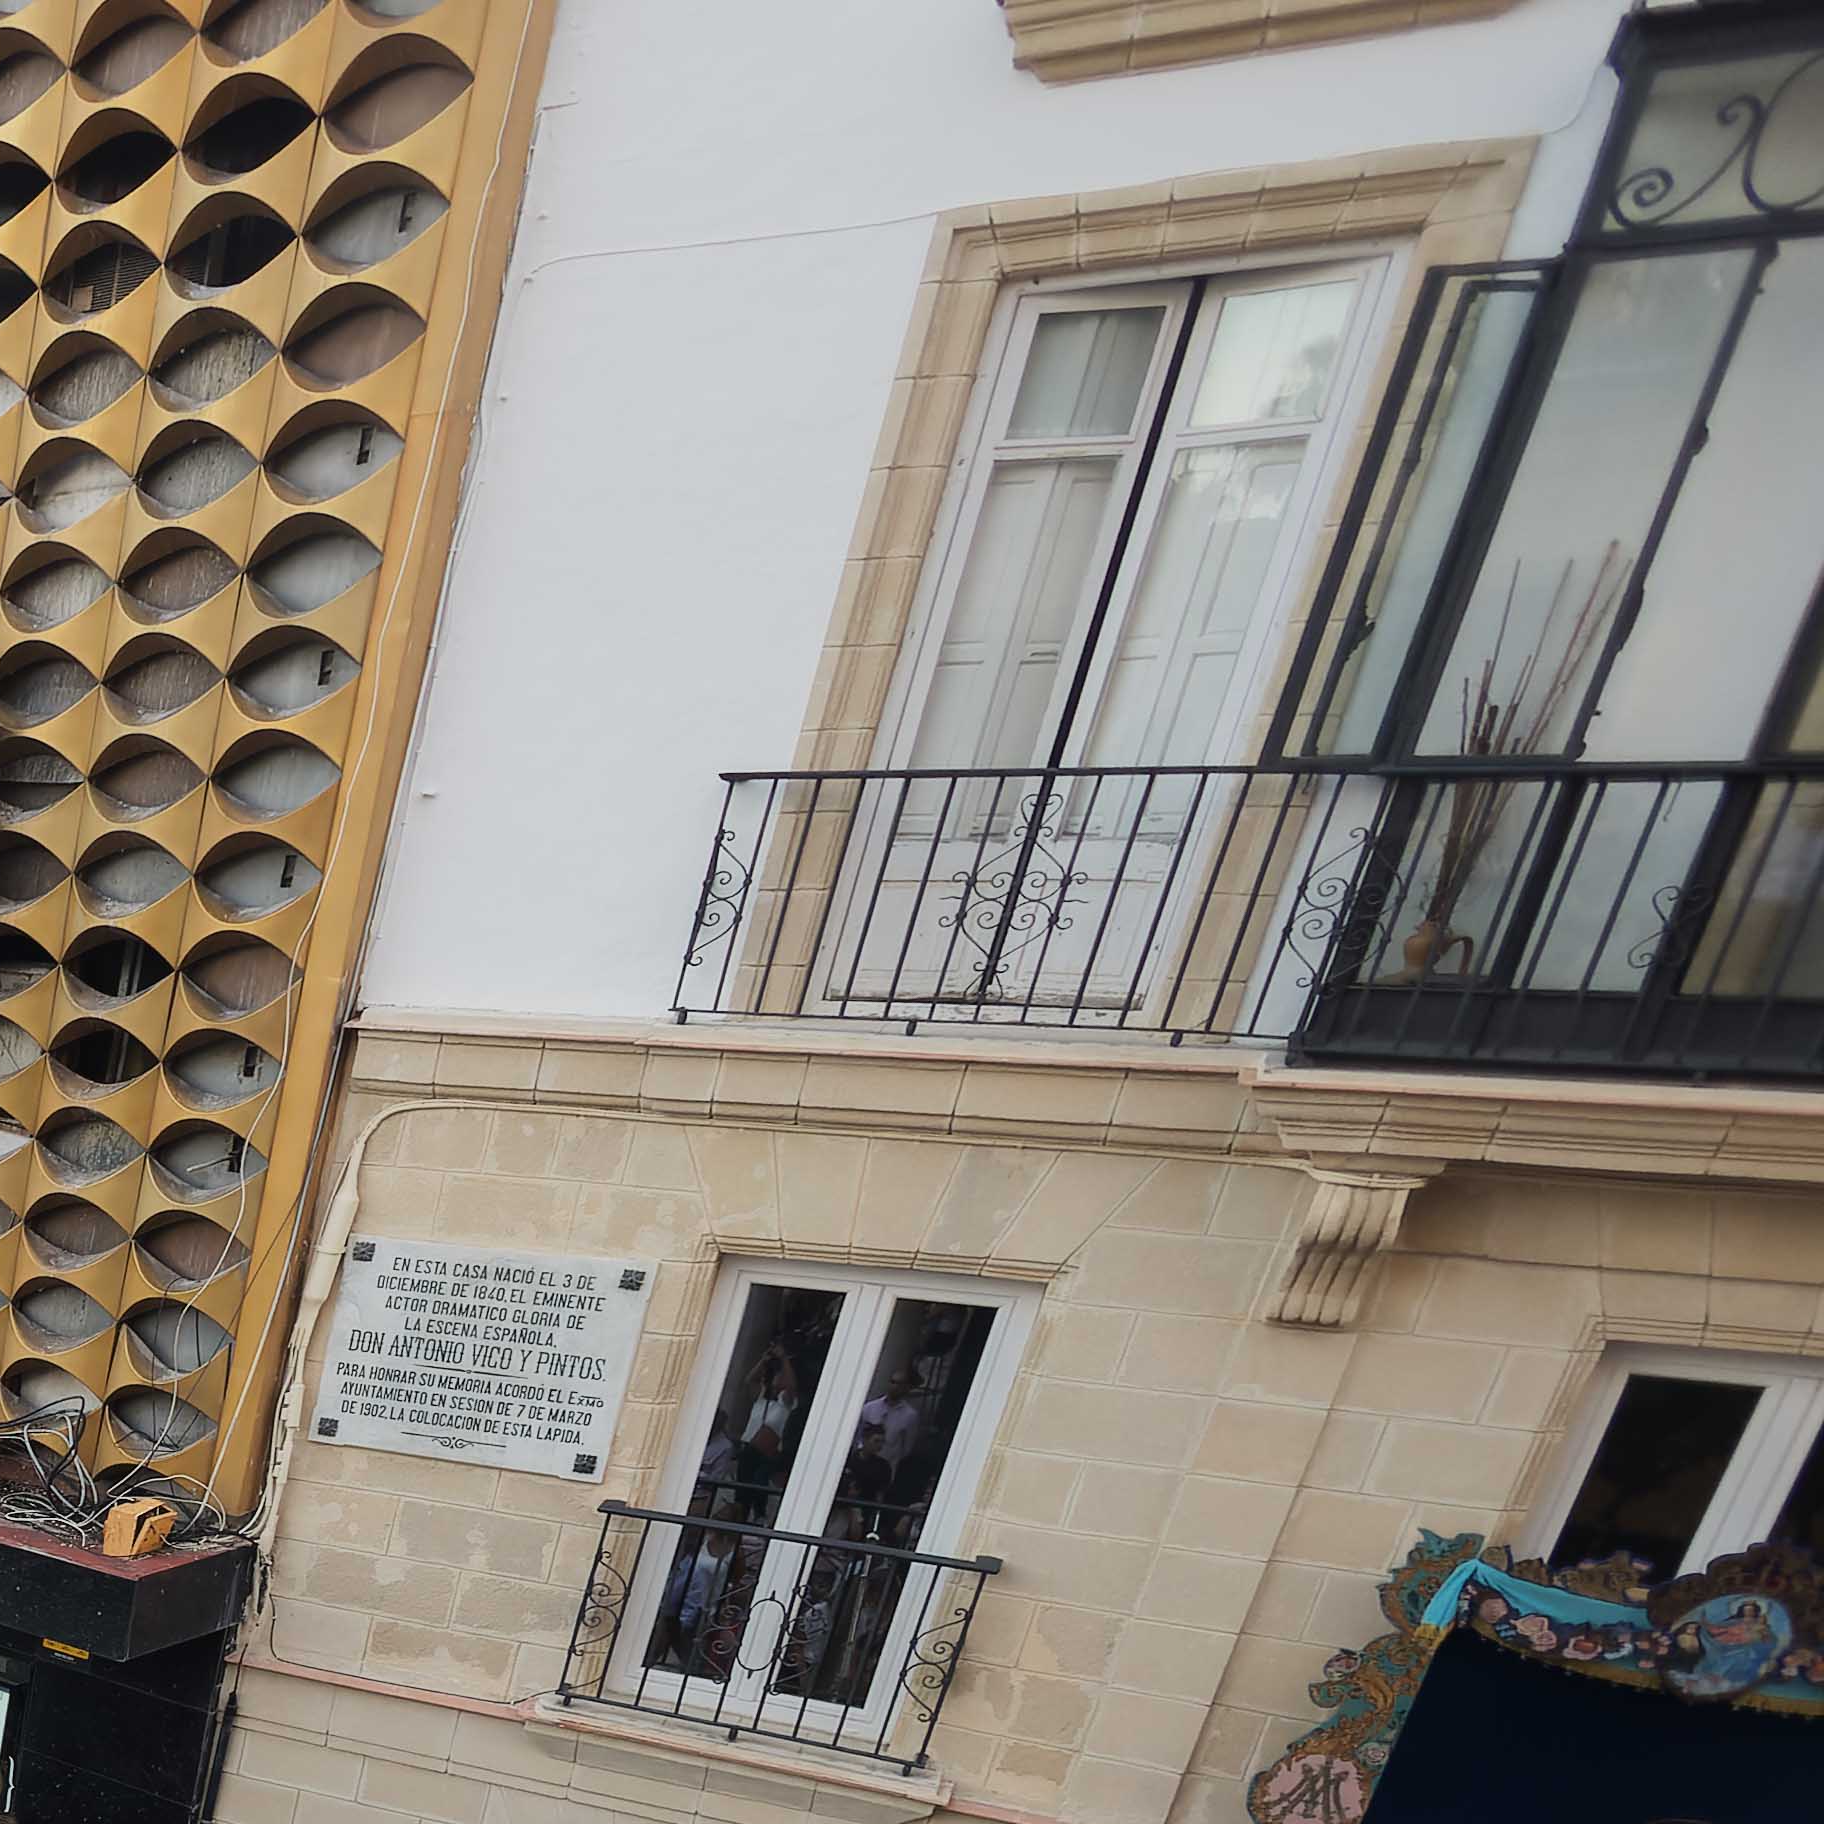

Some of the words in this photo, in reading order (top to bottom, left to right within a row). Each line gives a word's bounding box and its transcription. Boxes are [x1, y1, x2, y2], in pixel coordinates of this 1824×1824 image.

[377, 1275, 447, 1296] DICIEMBRE
[451, 1283, 470, 1298] DE
[533, 1291, 607, 1312] EMINENTE
[393, 1257, 411, 1272] EN
[415, 1259, 447, 1276] ESTA
[452, 1263, 488, 1280] CASA
[494, 1266, 535, 1284] NACIÓ
[539, 1271, 557, 1287] EL
[562, 1273, 573, 1288] 3
[576, 1275, 597, 1291] DE
[385, 1295, 428, 1313] ACTOR
[432, 1300, 507, 1322] DRAMATICO
[512, 1309, 560, 1328] GLORIA
[566, 1315, 587, 1330] DE
[404, 1317, 421, 1331] LA
[426, 1319, 478, 1338] ESCENA
[483, 1325, 557, 1348] ESPAÑOLA.
[348, 1329, 386, 1355] DON
[388, 1335, 465, 1364] ANTONIO
[472, 1343, 513, 1370] VICO
[519, 1349, 533, 1372] Y
[534, 1351, 606, 1382] PINTOS.
[336, 1362, 366, 1379] PARA
[369, 1366, 417, 1385] HONRAR
[419, 1373, 437, 1387] SU
[437, 1375, 492, 1395] MEMORIA
[495, 1382, 545, 1401] ACORDÓ
[547, 1388, 564, 1404] EL
[340, 1381, 428, 1405] AYUNTAMIENTO
[430, 1393, 447, 1408] EN
[449, 1395, 494, 1414] SESION
[496, 1401, 514, 1417] DE
[516, 1404, 526, 1418] 7
[528, 1405, 546, 1421] DE
[548, 1408, 592, 1426] MARZO
[341, 1400, 358, 1414] DE
[409, 1409, 481, 1432] COLOCACION
[484, 1419, 501, 1434] DE
[503, 1421, 532, 1438] ESTA
[536, 1426, 584, 1445] LAPIDA.
